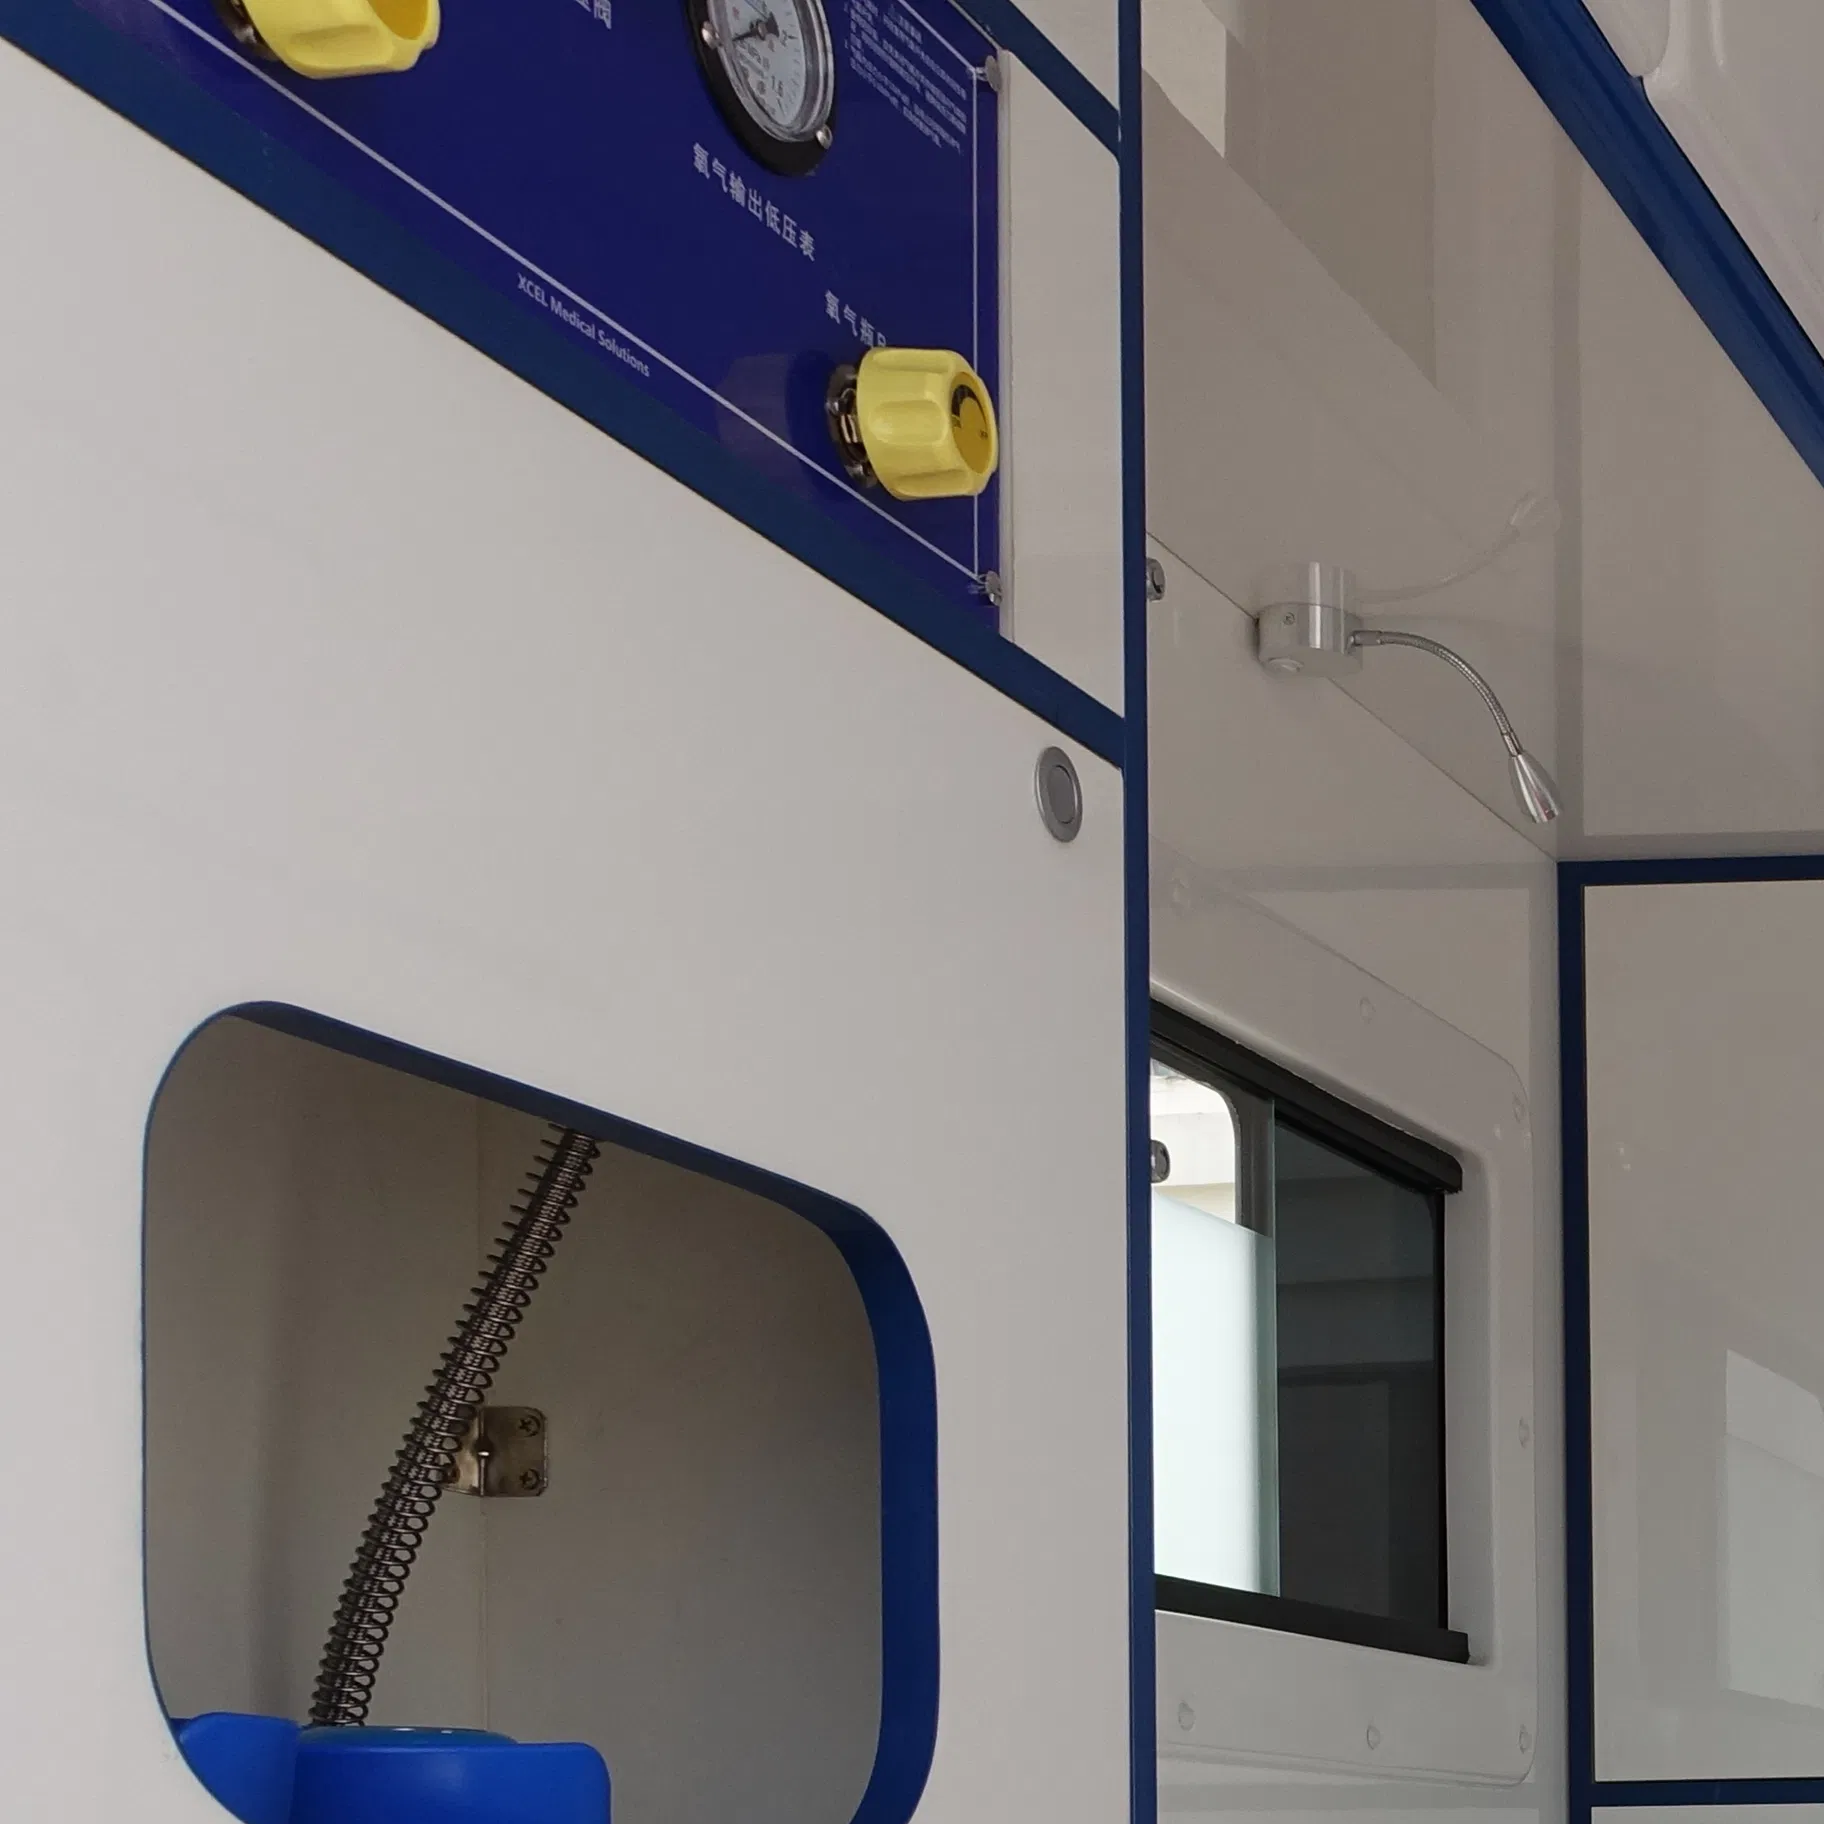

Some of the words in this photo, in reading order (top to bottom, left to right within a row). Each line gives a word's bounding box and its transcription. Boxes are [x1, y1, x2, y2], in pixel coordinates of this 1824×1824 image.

[692, 141, 816, 262] 氧气输出低压表
[517, 272, 549, 307] XCEL
[550, 295, 596, 340] Medical
[597, 329, 650, 378] Solutions
